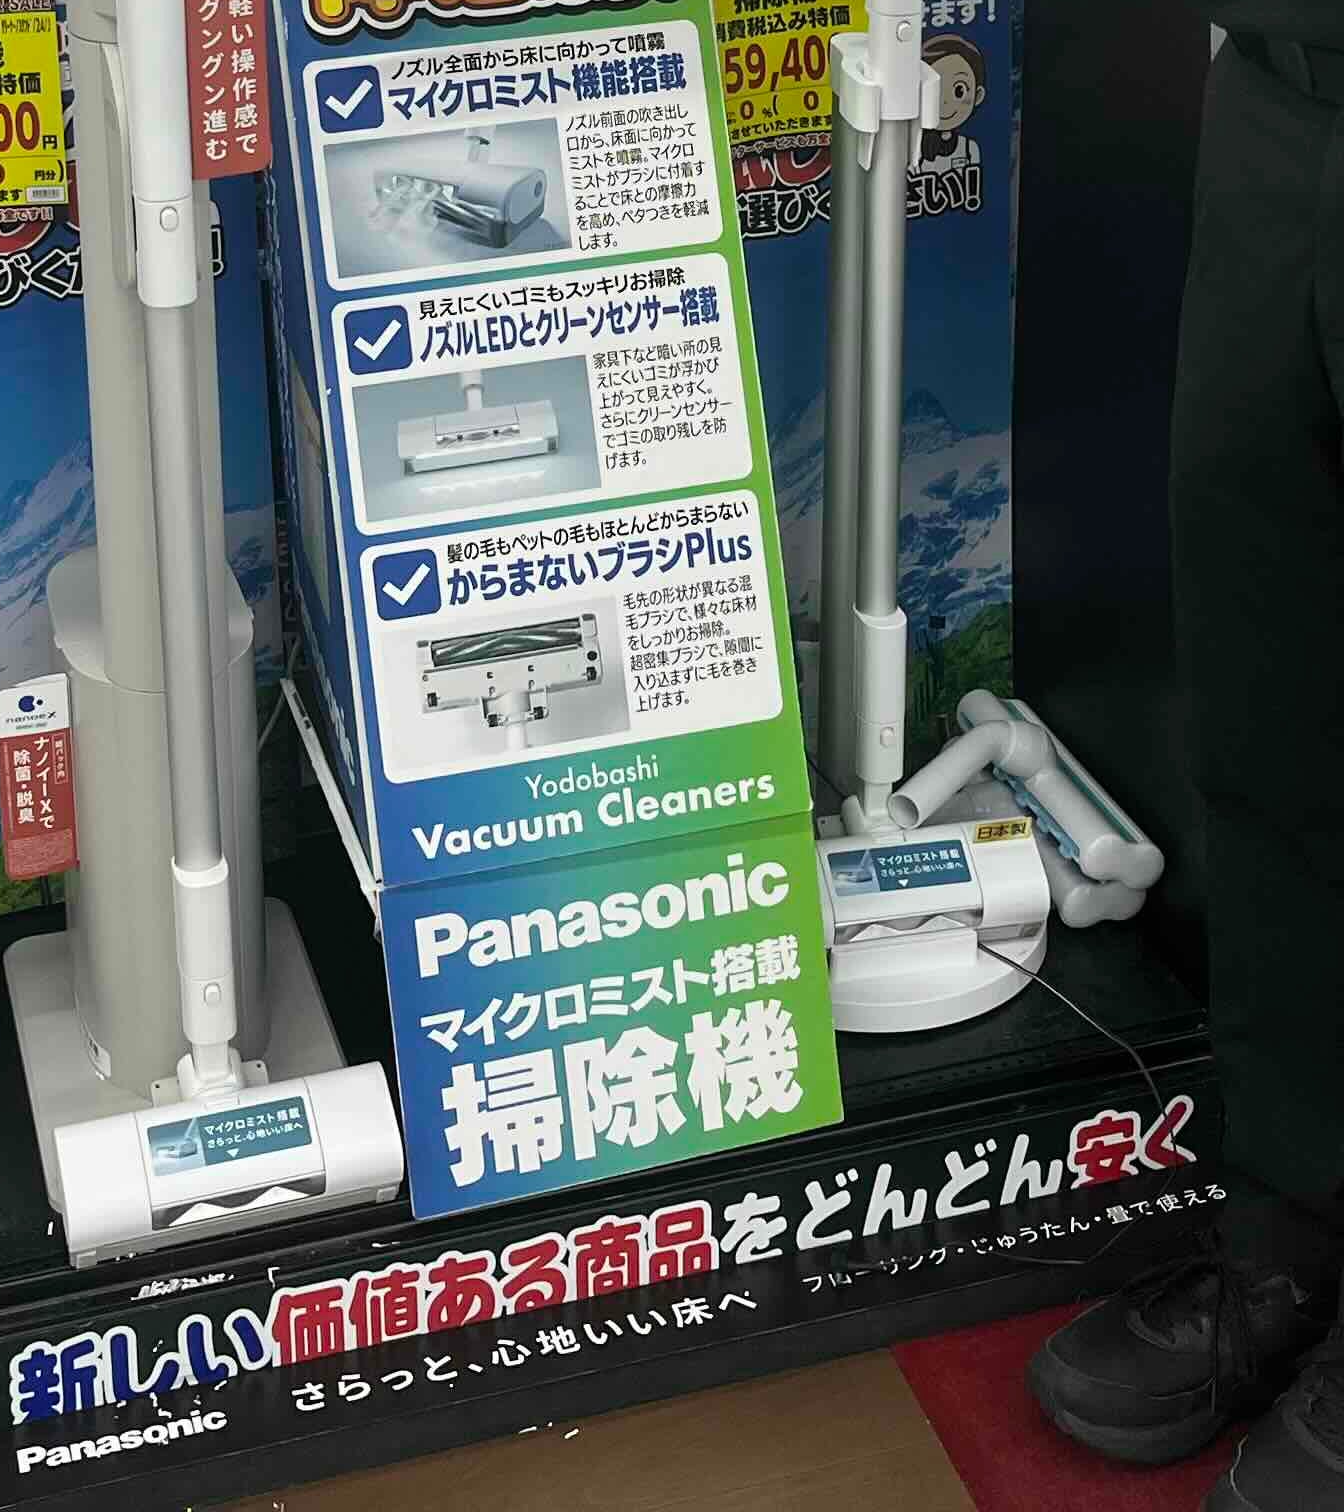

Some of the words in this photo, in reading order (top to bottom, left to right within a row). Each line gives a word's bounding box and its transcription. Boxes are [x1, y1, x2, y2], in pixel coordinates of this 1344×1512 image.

[391, 32, 666, 80] ノズル全面から床に向かって噴霧
[389, 54, 687, 120] マイクロミスト機能搭載
[566, 106, 688, 131] ノズル前面の吹き出し
[566, 123, 696, 152] 口から、床面に向かって
[568, 143, 694, 170] ミストを噴霧。マイクロ
[571, 161, 705, 190] ミストがブラシに付着す
[578, 233, 619, 250] します。
[418, 266, 686, 320] 見えにくいゴミもスッキリお掃除
[419, 287, 720, 362] ノズルLEDとクリーンセンサー搭載
[592, 337, 723, 369] 家具下など暗い所の見
[596, 358, 720, 388] えにくいゴミが浮かび
[598, 382, 712, 409] 上がって見えやすく。
[600, 399, 732, 429] さらにクリーンセンサー
[602, 419, 727, 449] でゴミの取り残しを防
[605, 451, 647, 470] げます。
[446, 502, 749, 564] 髪の毛もペットの毛もほとんどからまらない
[447, 529, 753, 607] からまないブラシPlus
[623, 576, 753, 609] 毛先の形状が異なる混
[625, 595, 757, 630] 毛ブラシで、様々な床材
[628, 622, 732, 650] をしっかりお掃除。
[630, 638, 763, 672] 超密集ブラシで、隙間に
[633, 658, 757, 691] 入り込まずに毛を巻き
[636, 693, 690, 712] 上げます。
[13, 750, 35, 825] 除菌・脱臭
[33, 736, 55, 829] ナノイーXで
[524, 755, 660, 800] Yodobashi
[412, 808, 584, 860] Vacuum
[597, 774, 775, 827] Cleaners
[976, 819, 1028, 841] 日本製
[876, 846, 962, 869] マイクロミスト搭載
[412, 851, 790, 979] Panasonic
[419, 935, 802, 1054] マイクロミスト搭載
[442, 999, 804, 1188] 掃除機
[289, 1288, 758, 1413] さらっと、心地いい床へ
[13, 1406, 228, 1476] Panasonic
